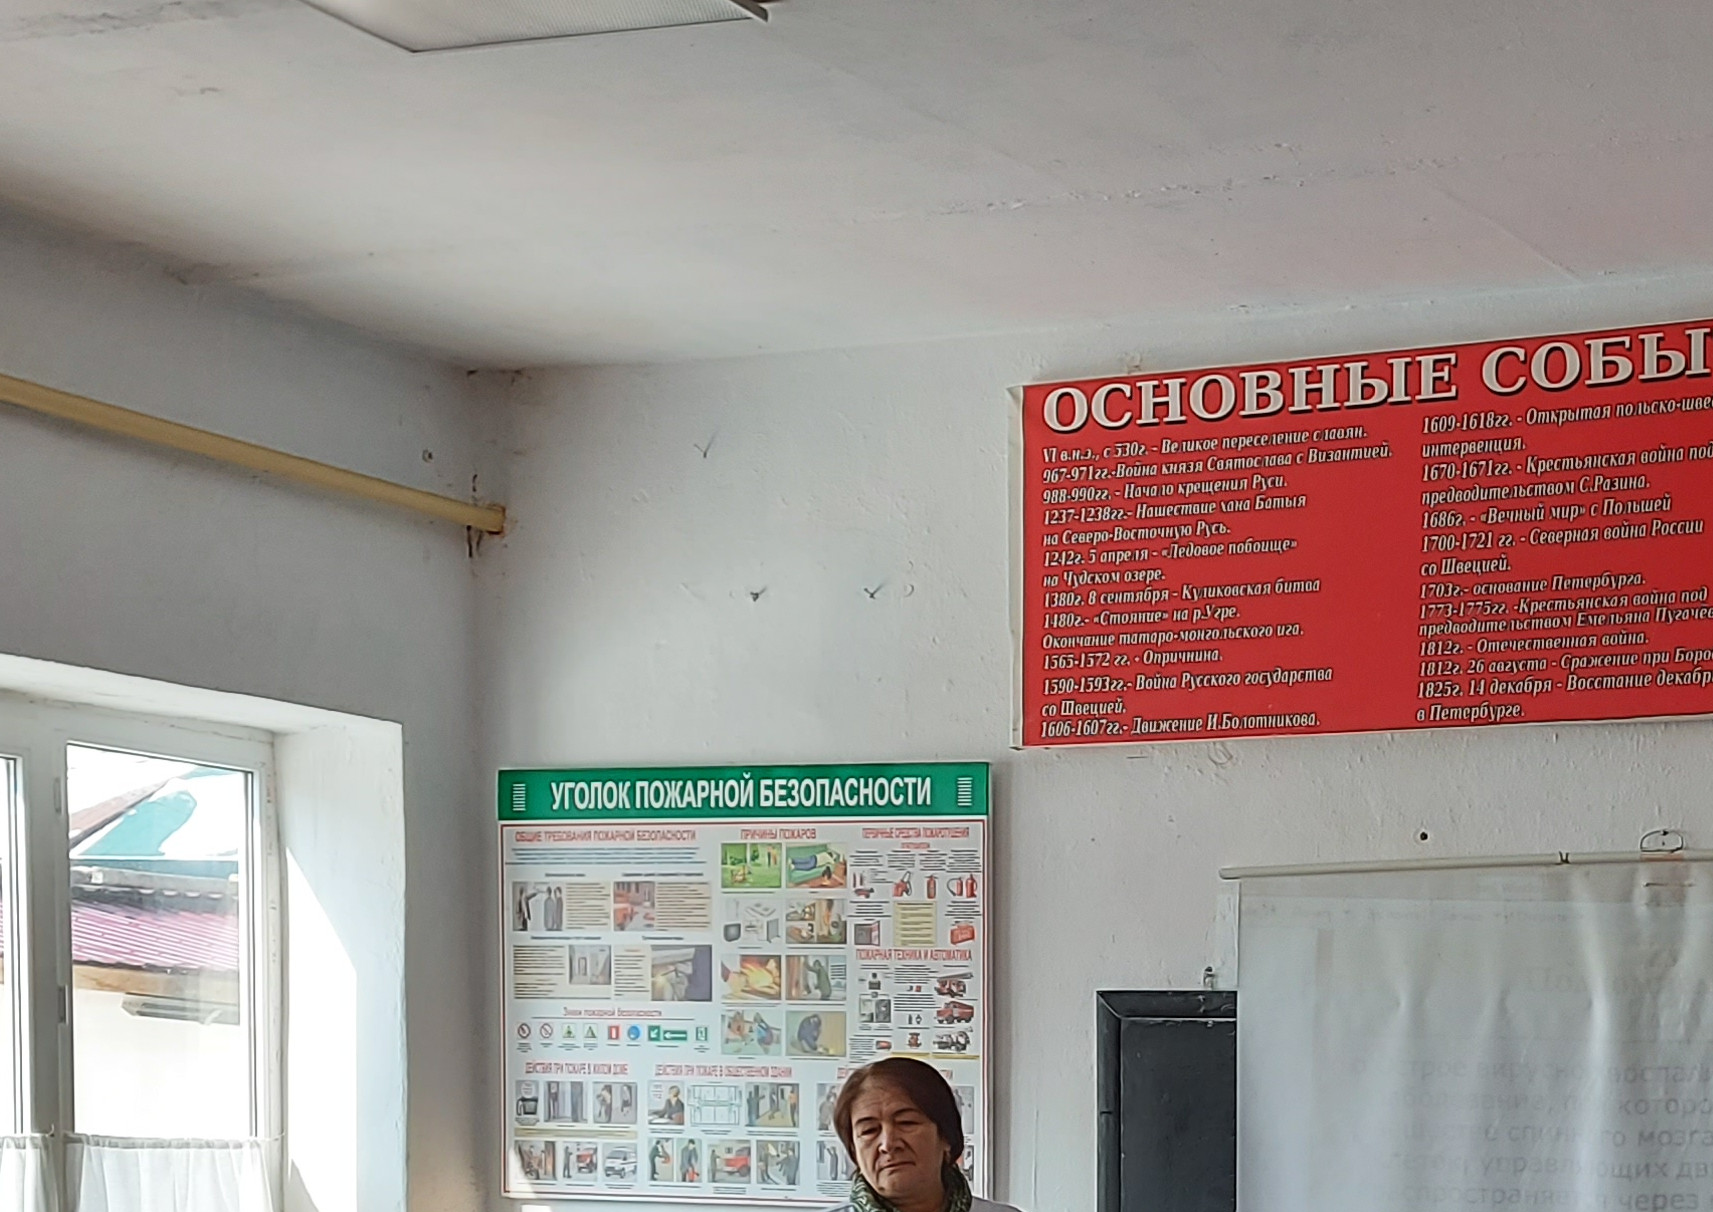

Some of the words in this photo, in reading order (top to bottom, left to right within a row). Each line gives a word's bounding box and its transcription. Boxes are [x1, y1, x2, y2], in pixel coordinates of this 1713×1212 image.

[1042, 352, 1458, 433] ОСНОВНЫЕ
[1161, 460, 1204, 475] князя
[1206, 453, 1293, 472] Святослава
[1296, 452, 1305, 465] с
[1307, 441, 1393, 464] Византией.
[1421, 437, 1527, 459] интервенция.
[1421, 481, 1576, 509] предводительством
[1579, 475, 1651, 494] С.Разина.
[1135, 502, 1217, 520] Нашествие
[1220, 499, 1251, 513] хана
[1254, 494, 1307, 511] Батыя
[1422, 510, 1467, 530] 1686г.
[1479, 502, 1545, 525] «Вечный
[1590, 503, 1599, 517] с
[1602, 492, 1672, 516] Польшей
[1042, 533, 1059, 548] на
[1061, 524, 1193, 547] Северо-Восточную
[1195, 520, 1232, 539] Русь.
[1420, 563, 1438, 577] со
[1440, 553, 1512, 577] Швецией.
[1042, 575, 1060, 588] на
[1063, 569, 1121, 590] Чудском
[1123, 568, 1166, 586] озере.
[1472, 579, 1548, 596] основание
[1551, 571, 1647, 592] Петербурга.
[1172, 609, 1189, 622] на
[1192, 603, 1241, 624] р.Угре.
[1420, 600, 1510, 620] 1773-1775гг.
[1632, 589, 1677, 606] война
[1680, 585, 1708, 604] под
[1042, 633, 1116, 650] Окончание
[1118, 625, 1274, 648] татаро-монгольского
[1276, 623, 1305, 637] ига.
[1418, 616, 1573, 640] предводительством
[1576, 611, 1651, 627] Емельяна
[1135, 673, 1178, 691] Война
[1180, 672, 1242, 692] Русского
[1244, 667, 1333, 689] государства
[1041, 704, 1058, 718] со
[1060, 697, 1127, 719] Швецией.
[1416, 708, 1426, 722] в
[1429, 701, 1525, 725] Петербурге.
[1130, 716, 1204, 735] Движение
[1206, 712, 1321, 731] И.Болотникова.
[551, 780, 631, 810] УГОЛОК
[635, 771, 754, 809] ПОЖАРНОЙ
[759, 777, 932, 808] БЕЗОПАСНОСТИ
[740, 828, 778, 840] ПРИЧИНЫ
[778, 828, 817, 840] ПОЖАРОВ
